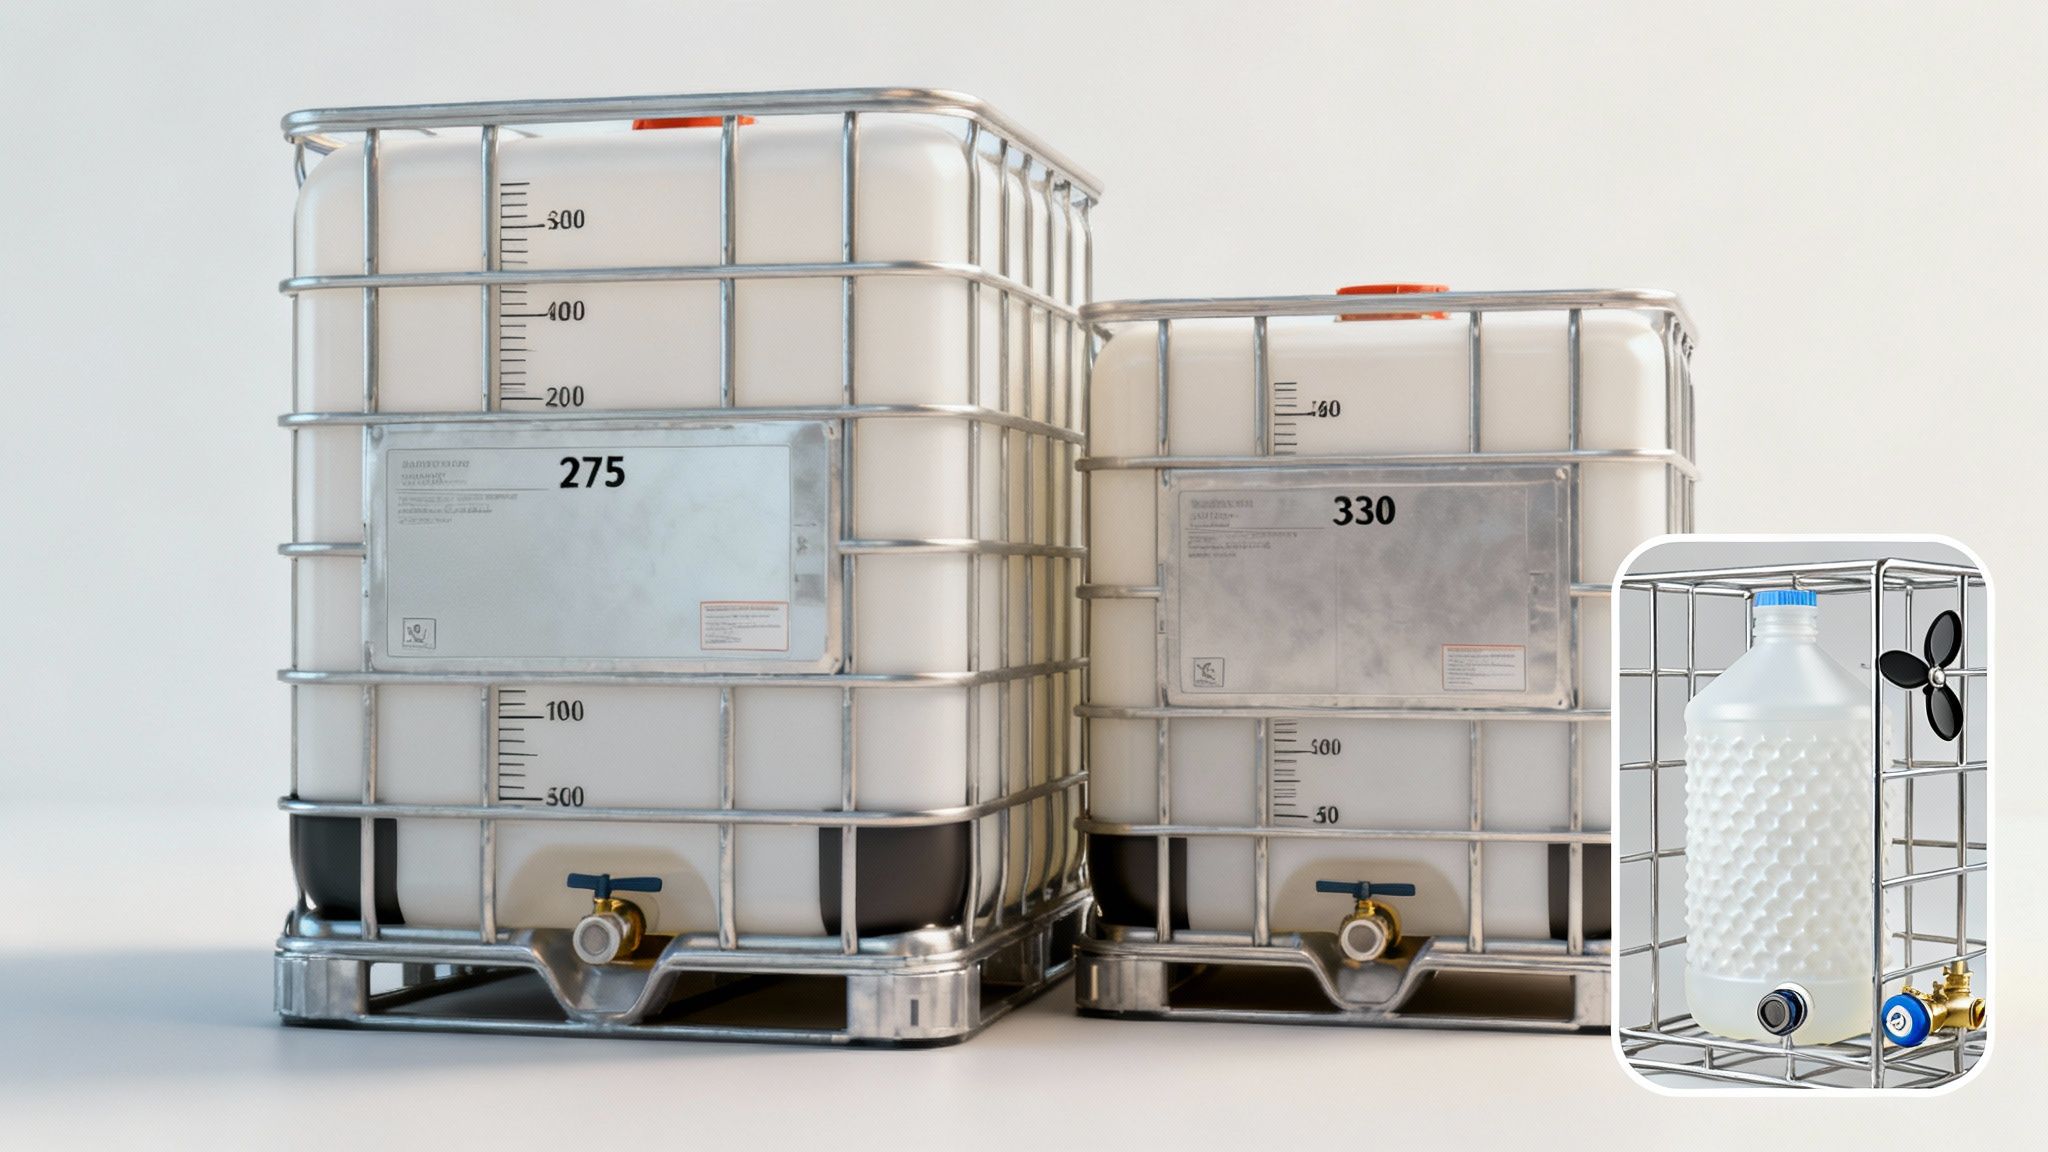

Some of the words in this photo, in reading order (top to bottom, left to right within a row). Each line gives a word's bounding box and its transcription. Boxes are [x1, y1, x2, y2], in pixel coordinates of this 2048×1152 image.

[545, 385, 585, 407] 200
[559, 456, 625, 488] 275
[1333, 495, 1396, 525] 330
[546, 700, 585, 721] 100
